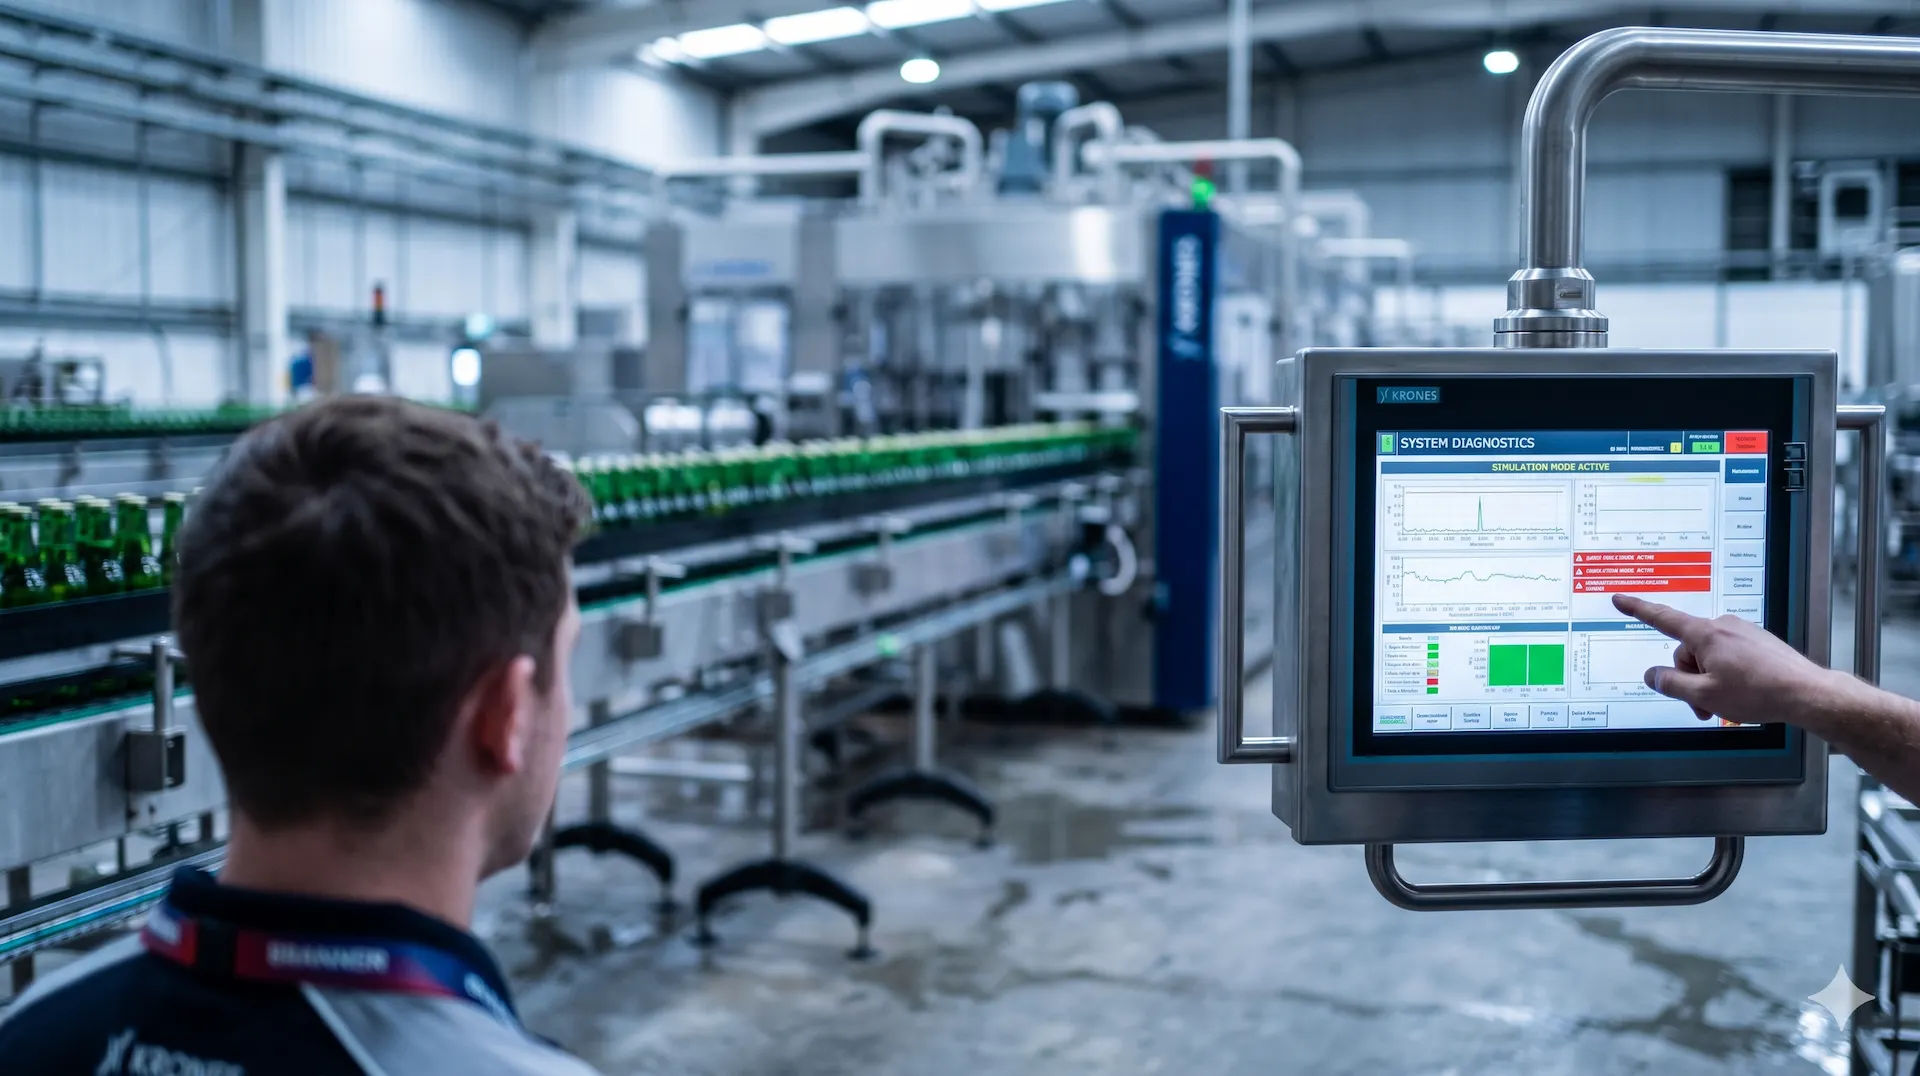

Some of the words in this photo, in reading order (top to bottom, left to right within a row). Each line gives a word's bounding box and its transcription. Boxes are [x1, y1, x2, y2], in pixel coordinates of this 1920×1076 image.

[1392, 390, 1437, 401] KRONES
[1400, 437, 1448, 449] SYSTEM
[1452, 437, 1536, 449] DIAGNOSTICS
[1491, 463, 1549, 471] SIMULATION
[1550, 463, 1576, 471] MODE
[1577, 462, 1610, 471] ACTIVE
